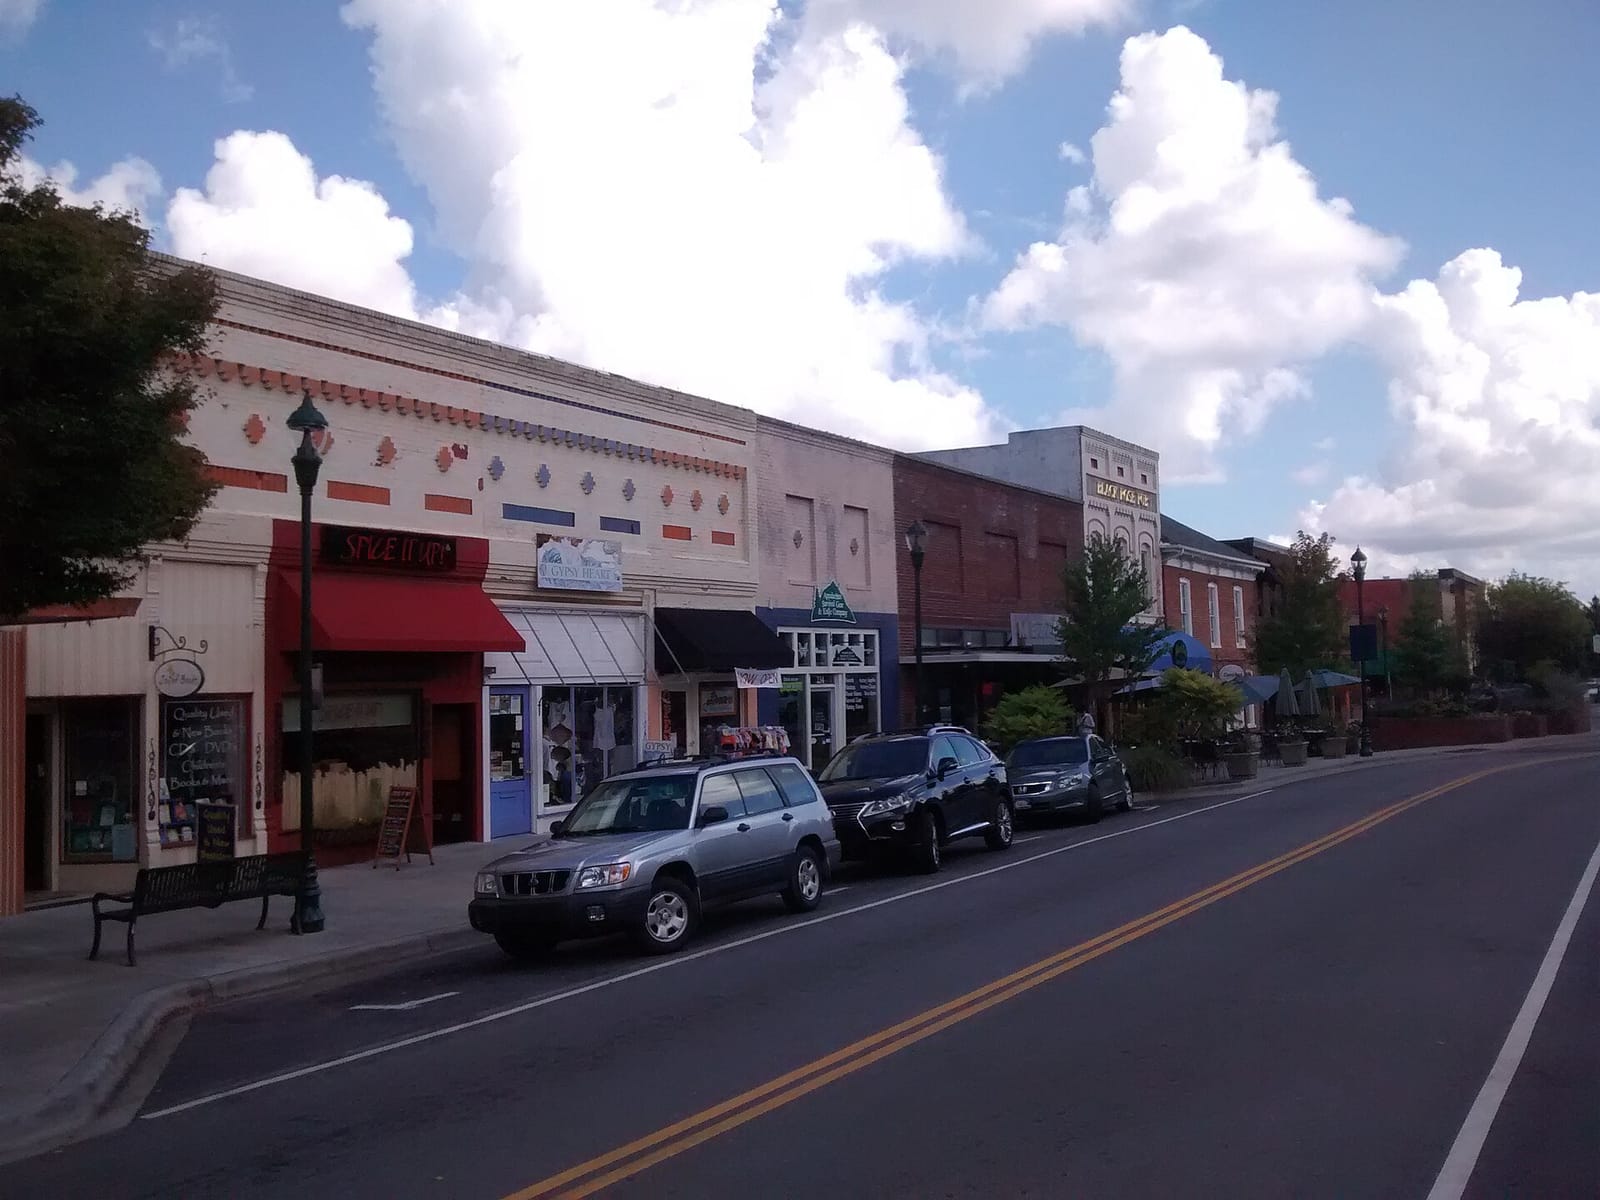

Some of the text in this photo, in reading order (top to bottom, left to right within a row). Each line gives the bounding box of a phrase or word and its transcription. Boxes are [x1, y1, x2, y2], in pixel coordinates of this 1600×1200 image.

[341, 533, 446, 566] SPICE IT UP!
[551, 565, 610, 579] GYPSY HEART
[760, 671, 779, 685] OPEN
[645, 742, 671, 751] GYPSY
